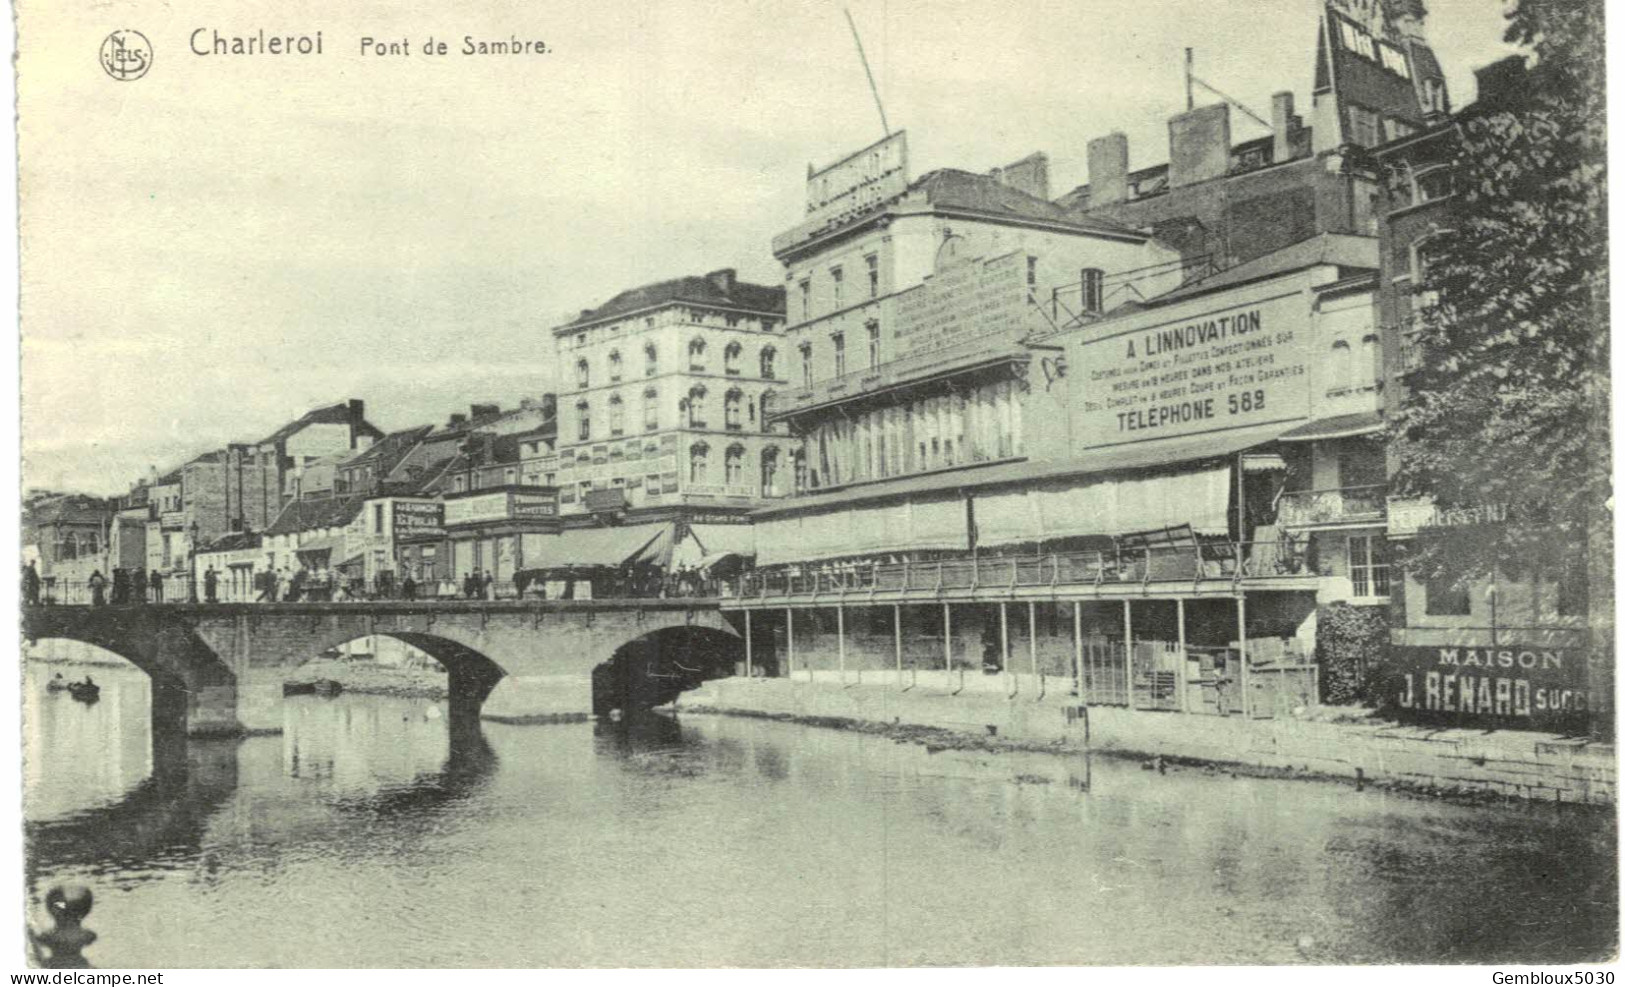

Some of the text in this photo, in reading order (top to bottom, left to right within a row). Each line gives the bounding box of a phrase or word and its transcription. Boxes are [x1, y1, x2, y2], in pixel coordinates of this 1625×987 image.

[1127, 340, 1137, 359] A
[1160, 369, 1188, 384] HEURES
[1191, 365, 1212, 379] DANS
[1215, 361, 1231, 374] NOS
[1235, 353, 1275, 370] ATELIERS
[1116, 389, 1266, 433] TÉLÉPHONE 582
[1438, 648, 1564, 669] MAISON
